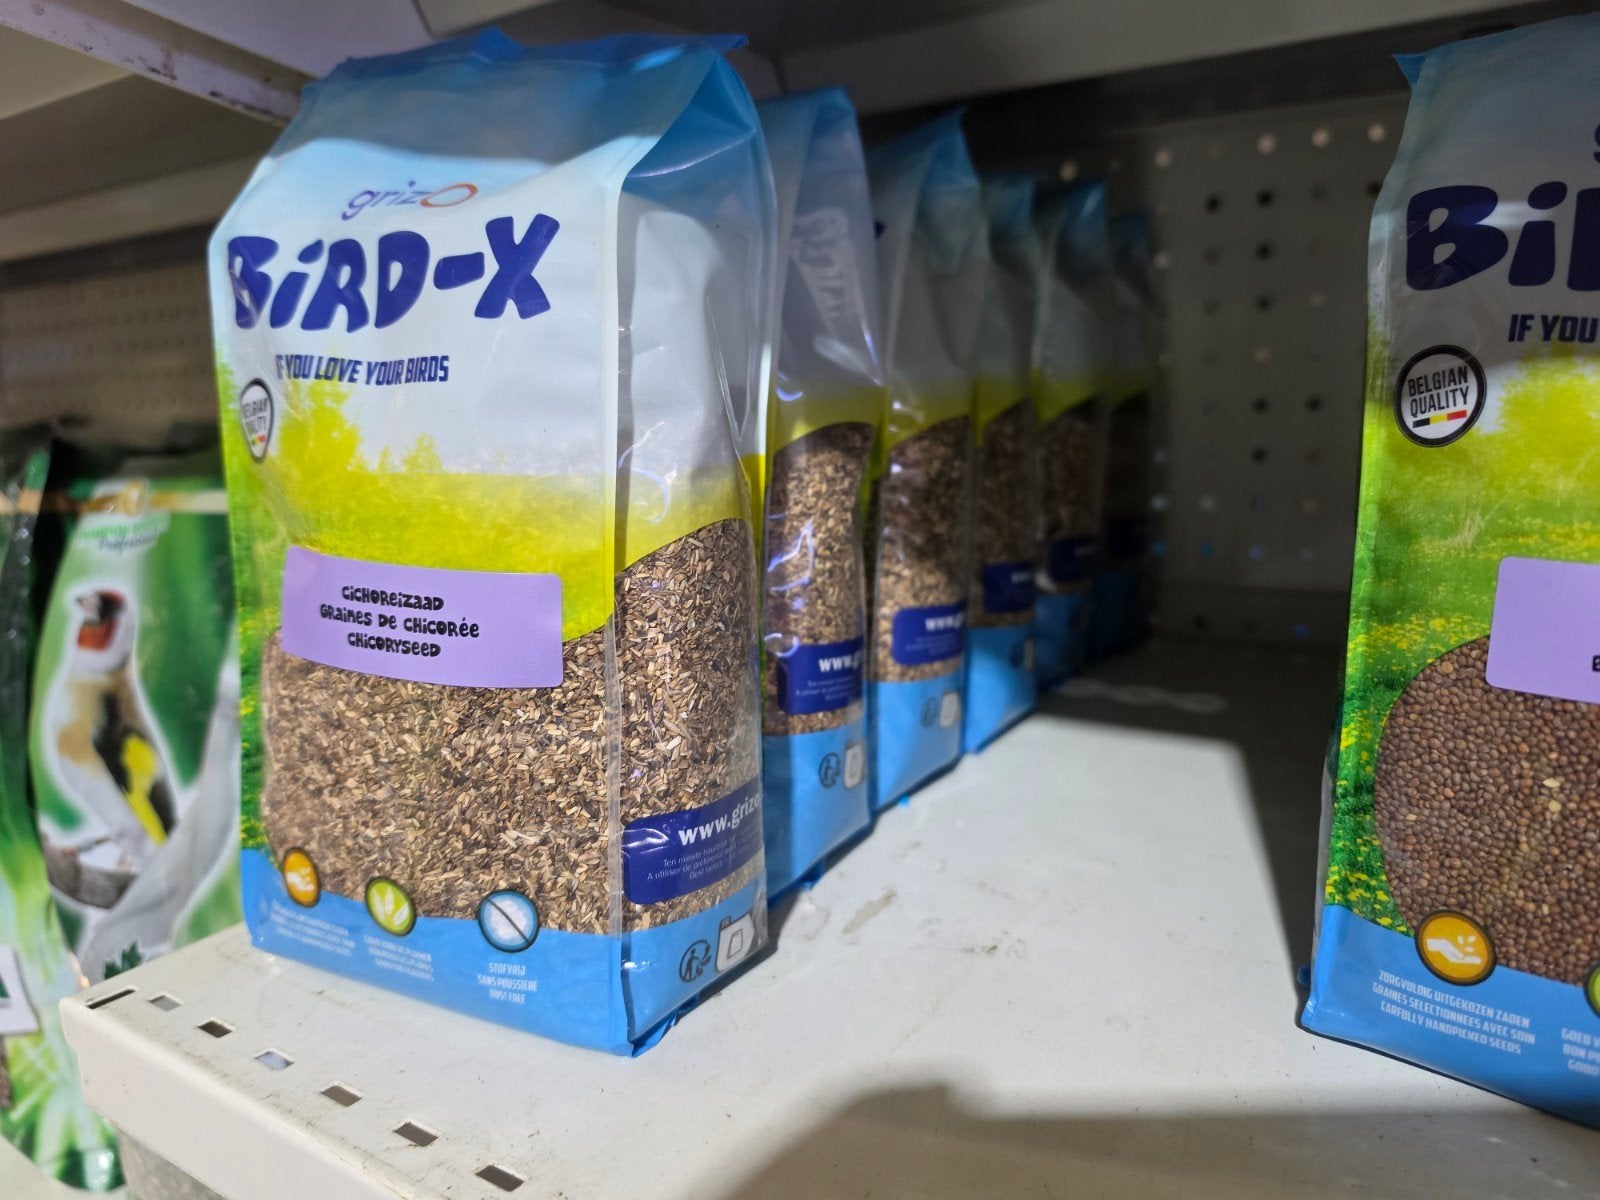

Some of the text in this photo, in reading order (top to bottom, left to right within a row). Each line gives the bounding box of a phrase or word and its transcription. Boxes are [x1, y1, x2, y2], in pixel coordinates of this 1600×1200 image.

[341, 180, 479, 221] grizo
[1508, 313, 1599, 343] IF YOU
[285, 354, 314, 380] YOU
[315, 356, 363, 383] LOVE
[365, 359, 405, 386] YOUR
[405, 355, 450, 383] BIRDS
[1408, 365, 1468, 398] BELGIAN
[1410, 385, 1469, 418] QUALITY
[489, 962, 526, 976] STOFVRIJ
[1373, 982, 1536, 1045] GRAINES SELECTIONNEES AVEC SOIN
[1381, 1001, 1424, 1026] CARFULLY
[1489, 1037, 1521, 1054] SEEDS
[1495, 1009, 1531, 1029] ZADEN
